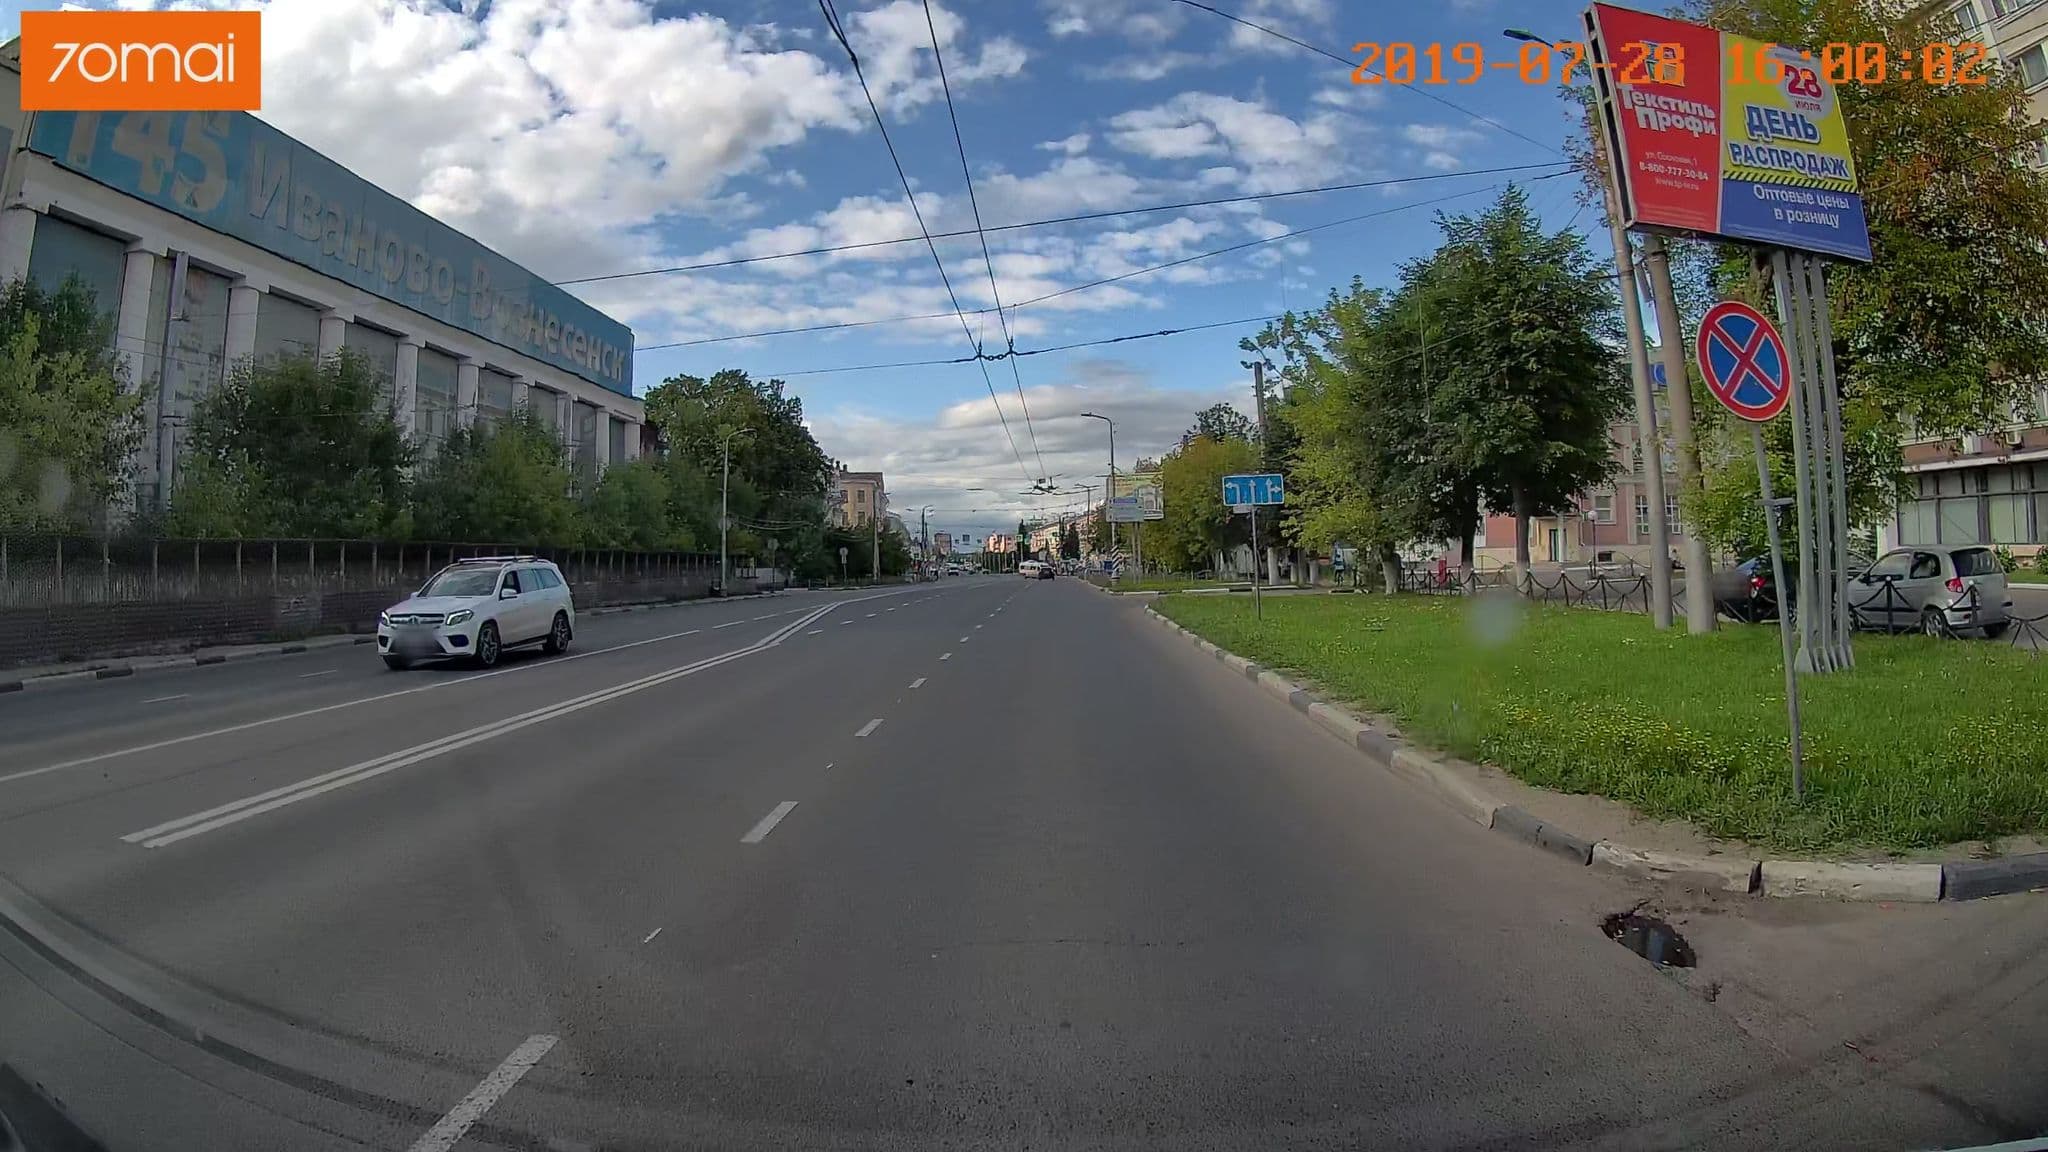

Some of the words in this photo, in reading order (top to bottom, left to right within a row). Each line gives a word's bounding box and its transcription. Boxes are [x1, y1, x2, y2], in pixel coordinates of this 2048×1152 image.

[1783, 64, 1824, 99] 28
[1617, 84, 1716, 119] Текстиль
[1635, 106, 1717, 138] Профи
[1745, 105, 1819, 142] ДЕНЬ
[67, 111, 228, 213] 145
[1729, 142, 1850, 180] РАСПРОДАЖ
[1753, 184, 1814, 205] Оптовые
[1816, 192, 1850, 209] цены
[1774, 208, 1783, 219] в
[1787, 209, 1839, 229] розницу
